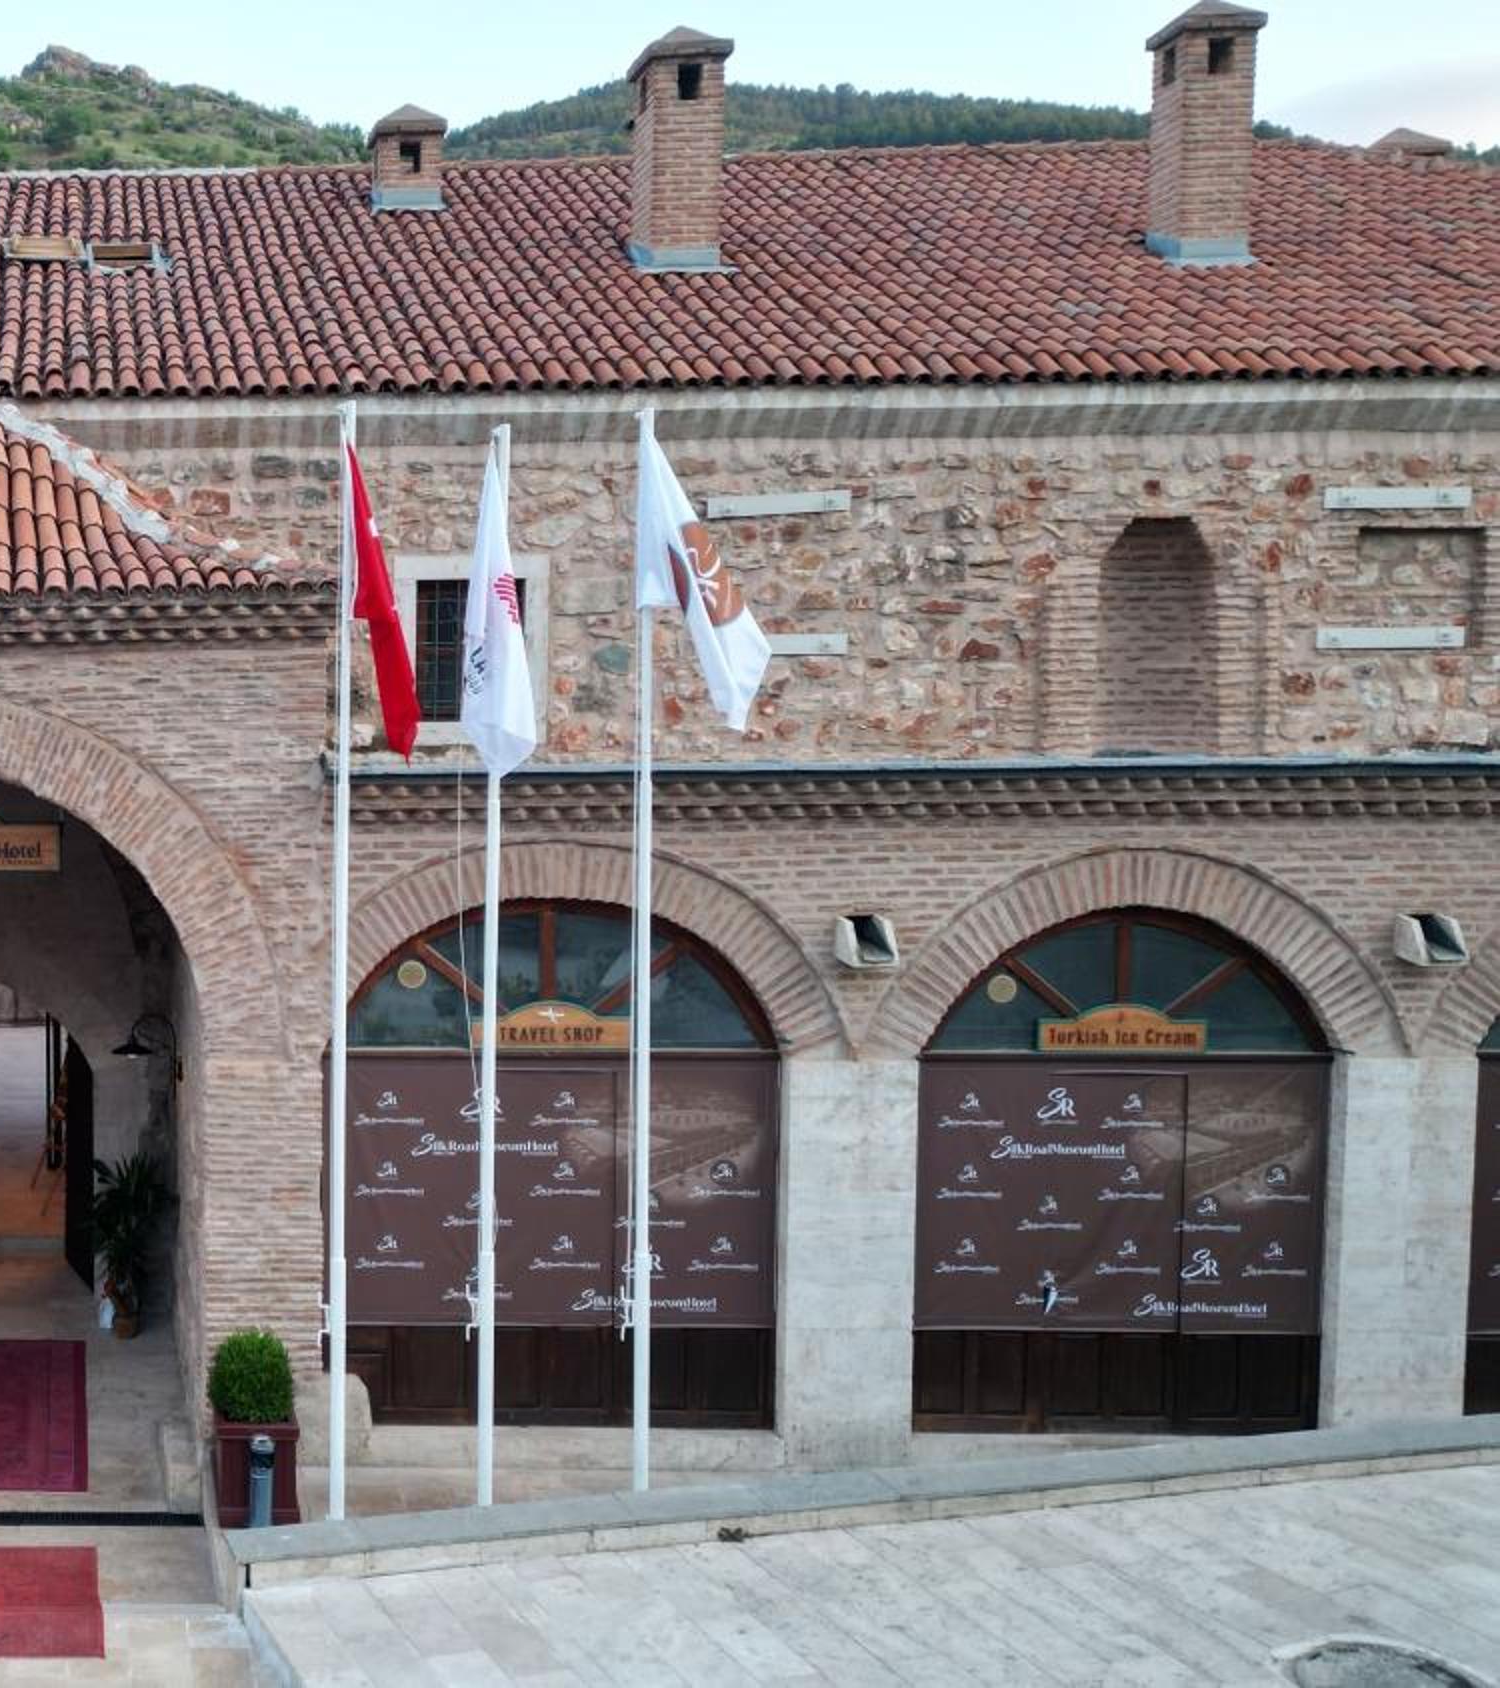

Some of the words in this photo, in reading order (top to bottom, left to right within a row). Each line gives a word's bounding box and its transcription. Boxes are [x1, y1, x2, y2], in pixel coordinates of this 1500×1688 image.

[500, 1027, 554, 1042] TRAVEL
[563, 1027, 605, 1042] SHOP
[1049, 1028, 1109, 1045] Turkish
[1116, 1028, 1139, 1045] Ice
[1145, 1028, 1197, 1046] Cream
